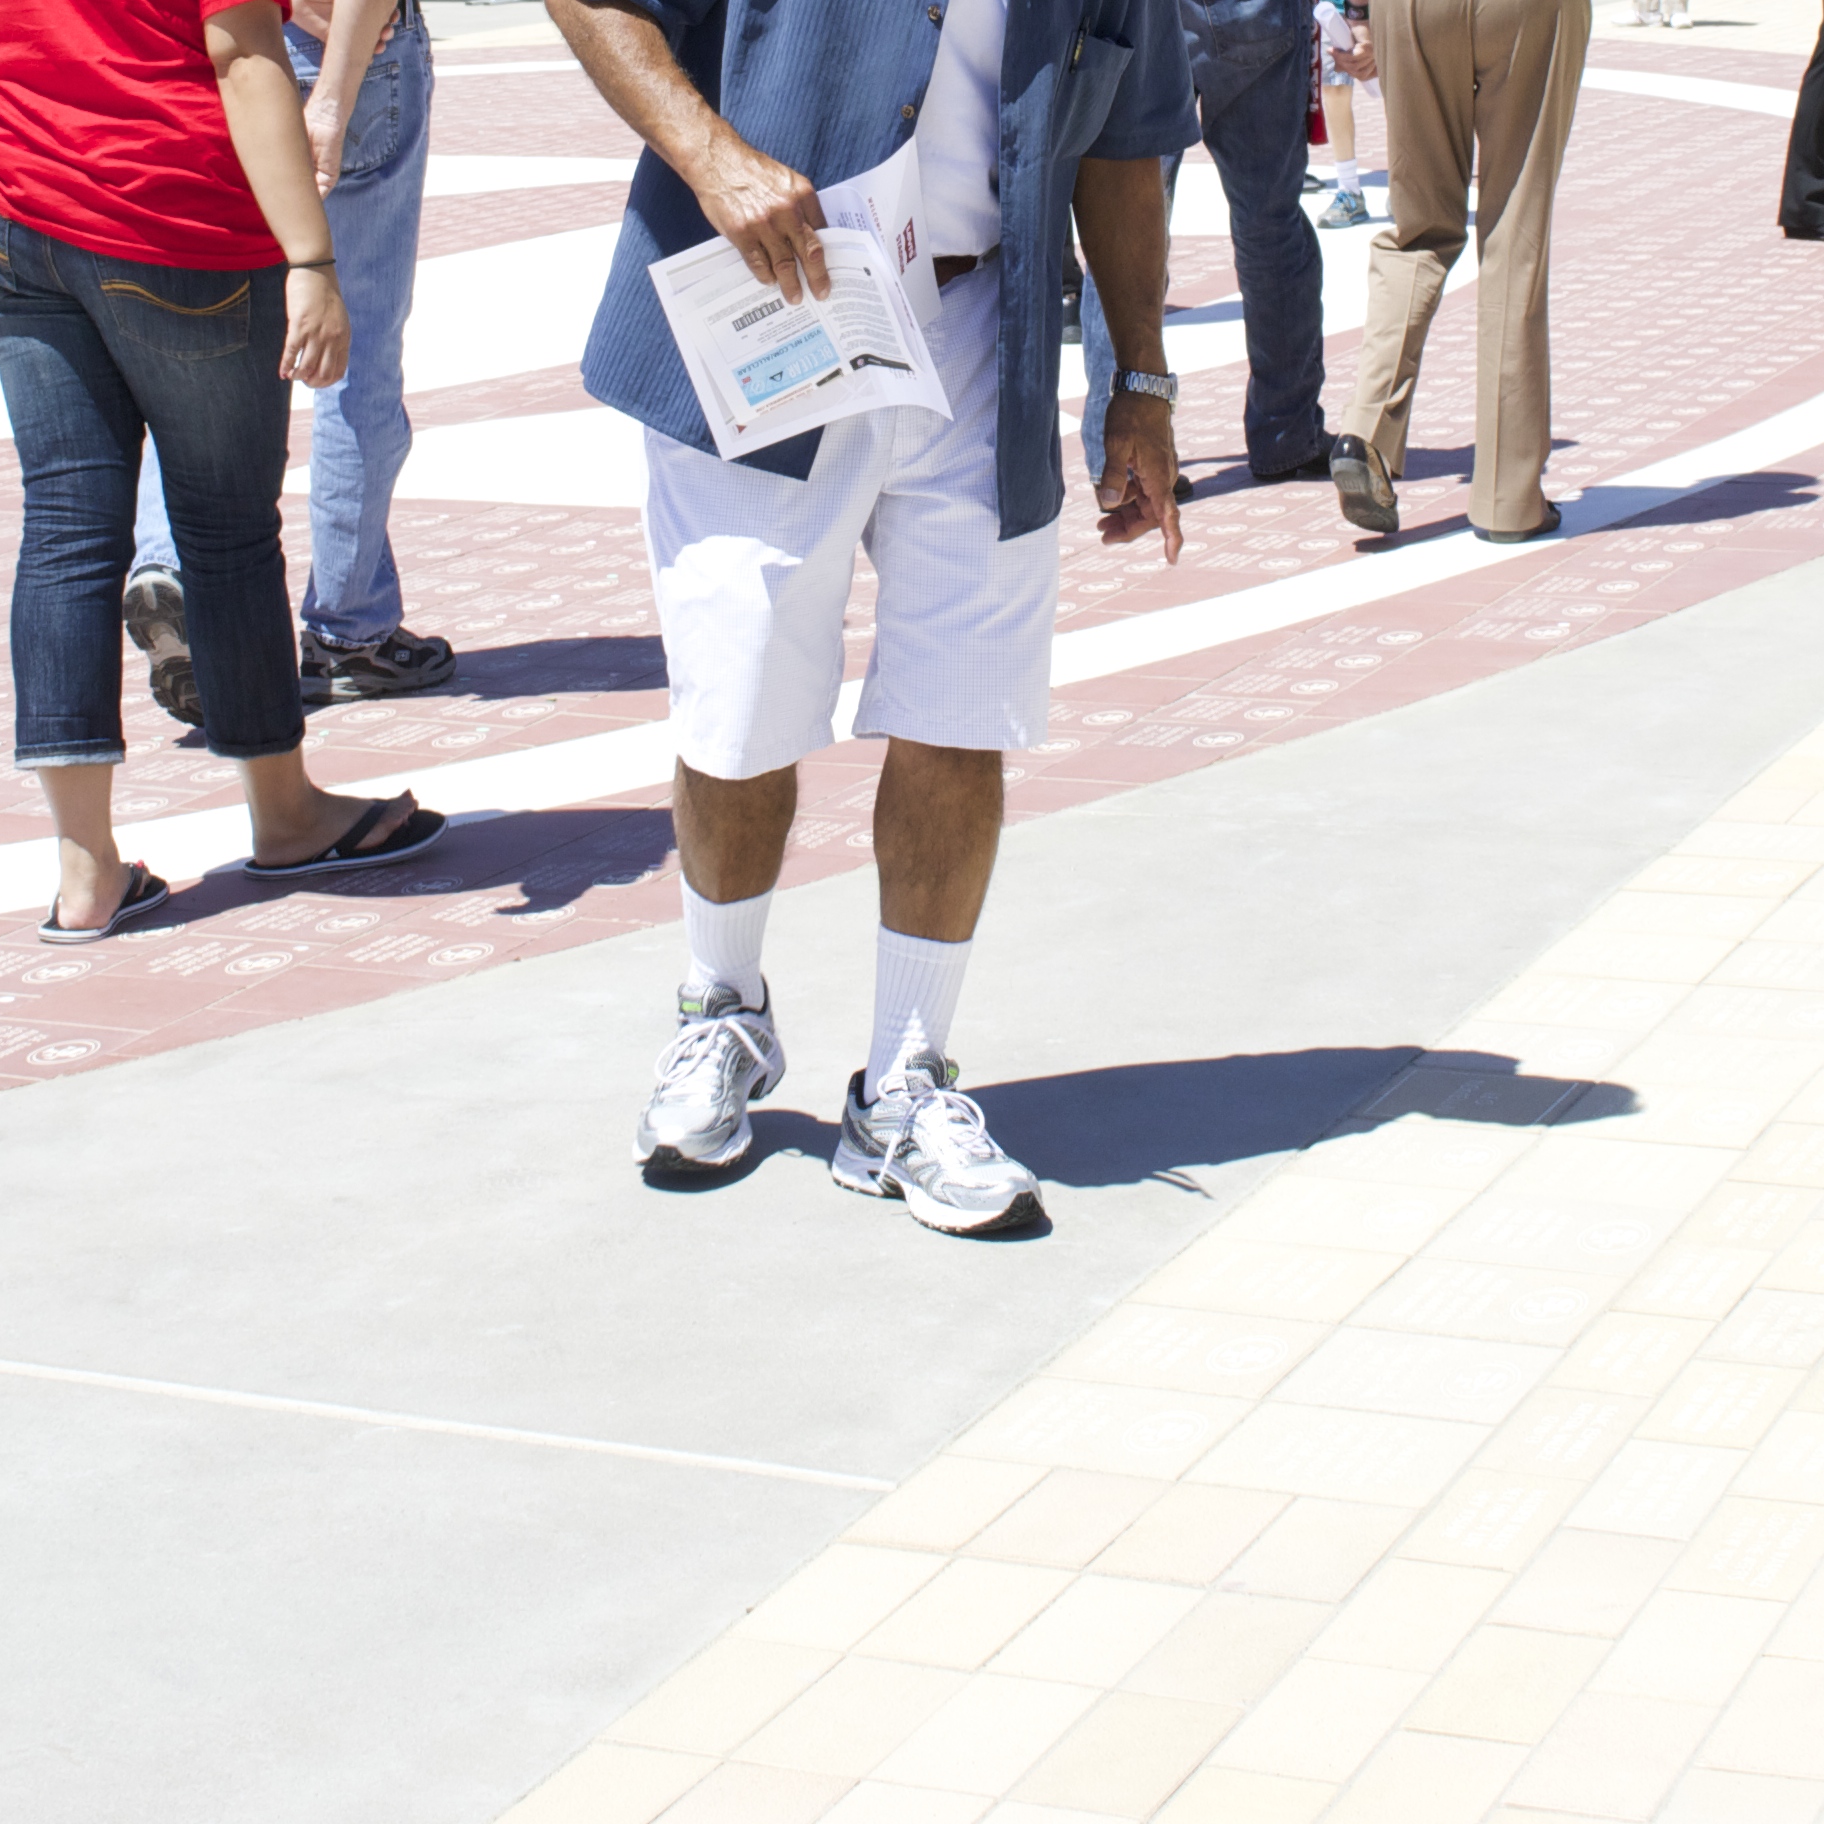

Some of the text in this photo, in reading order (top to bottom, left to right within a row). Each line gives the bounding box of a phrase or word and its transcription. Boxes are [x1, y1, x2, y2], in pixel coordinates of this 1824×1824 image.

[896, 234, 905, 276] STADIUM
[736, 328, 822, 376] VISIT NFL.COM/ALLCLEAR
